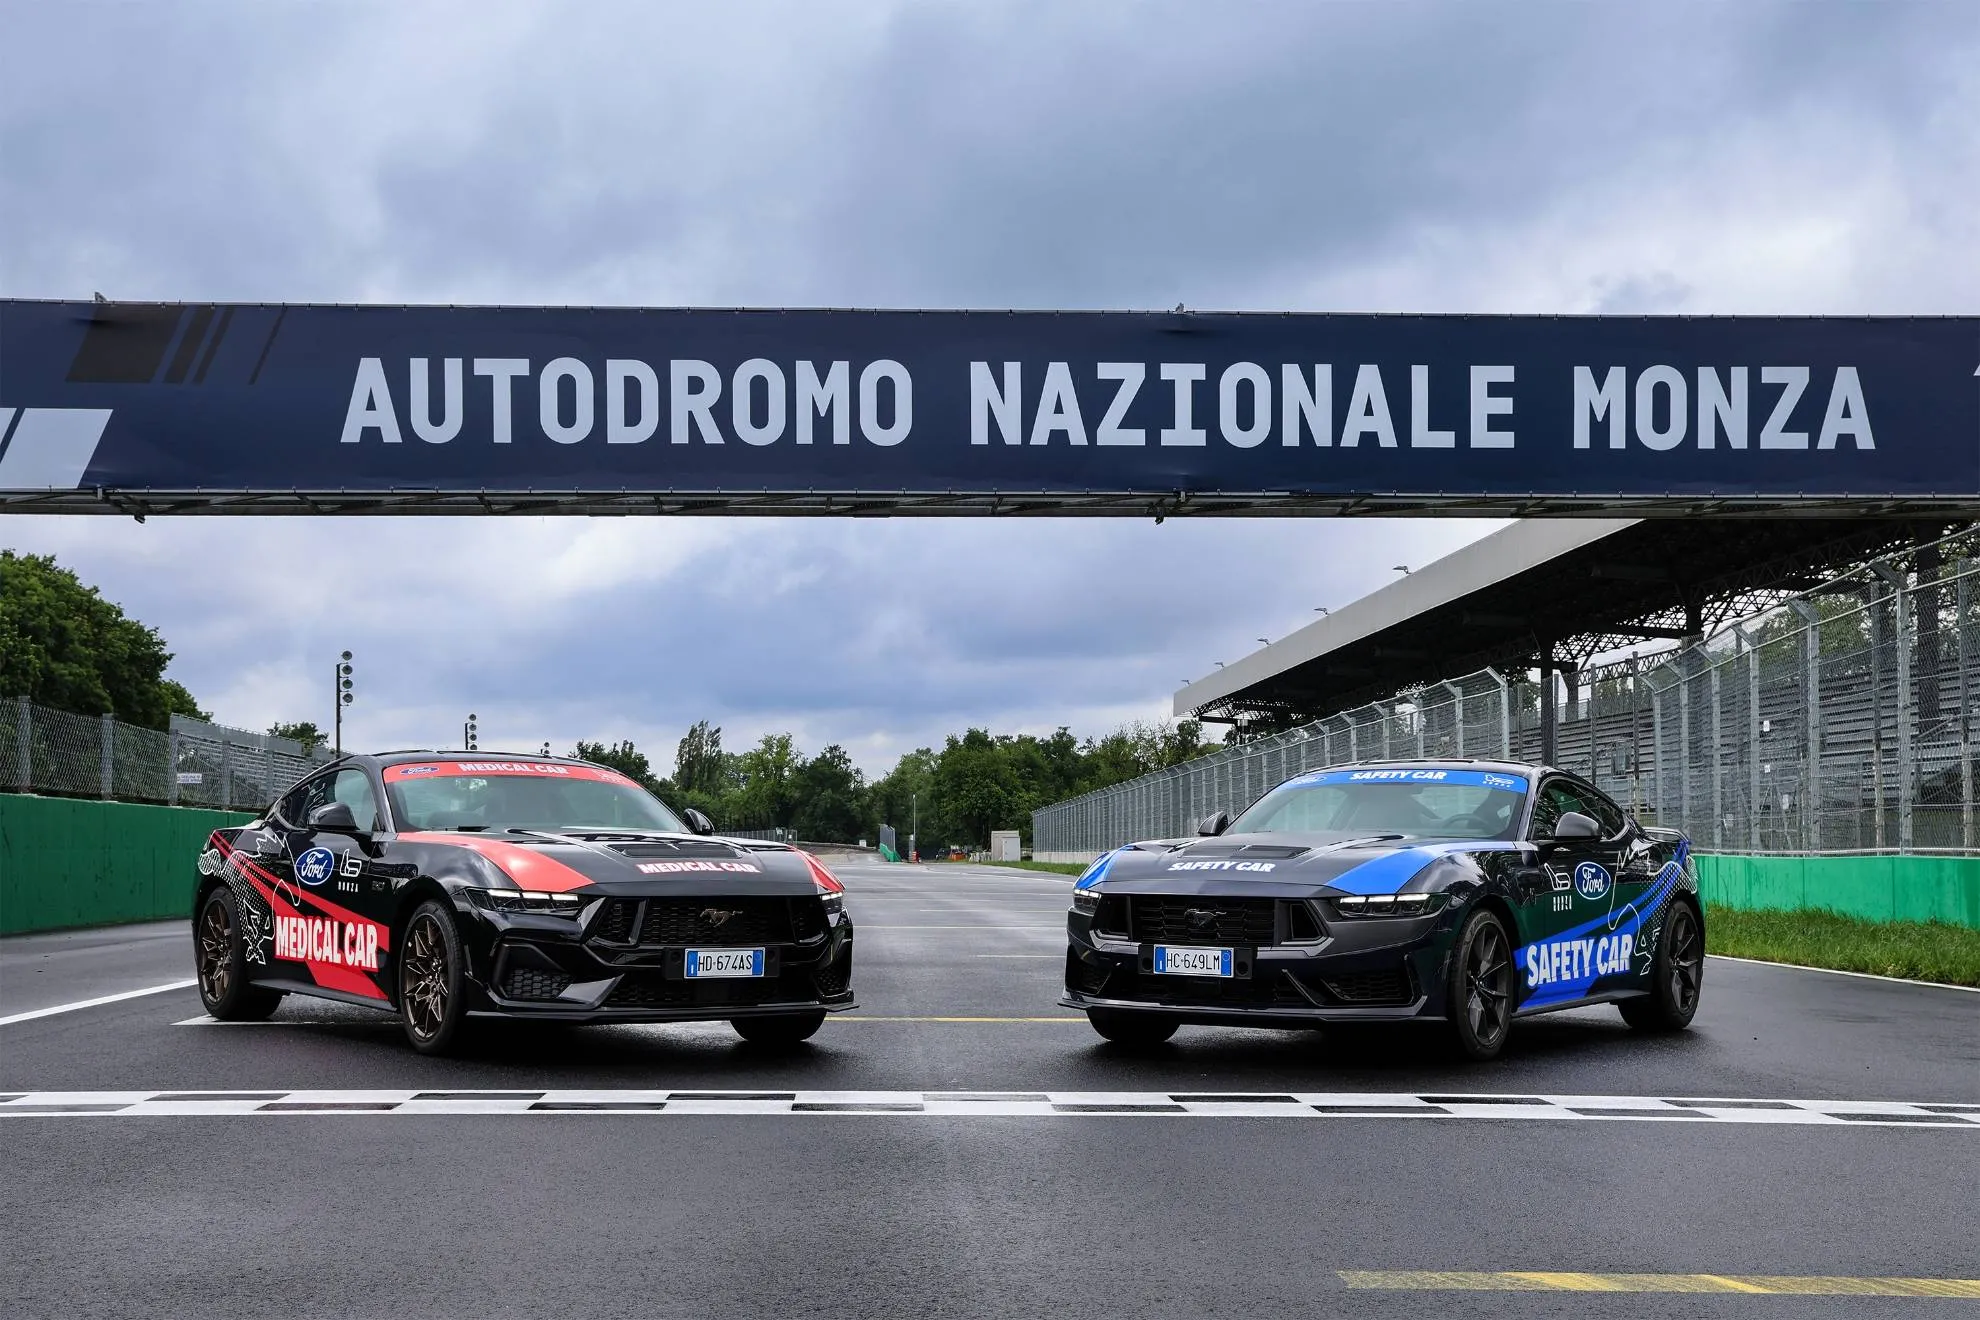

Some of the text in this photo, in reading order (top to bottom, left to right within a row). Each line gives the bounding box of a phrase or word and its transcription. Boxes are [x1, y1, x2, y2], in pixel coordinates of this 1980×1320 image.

[341, 357, 1876, 451] AUTODROMO NAZIONALE MONZA
[457, 763, 569, 775] MEDICAL CAR
[1349, 771, 1448, 780] SAFETY CAR
[301, 851, 328, 879] Ford
[636, 861, 762, 874] MEDICAL CAR
[1167, 860, 1276, 873] SAFETY CAR
[1581, 866, 1605, 893] Ford
[275, 915, 378, 969] MEDICAL CAR
[1526, 934, 1633, 987] SAFETY CAR
